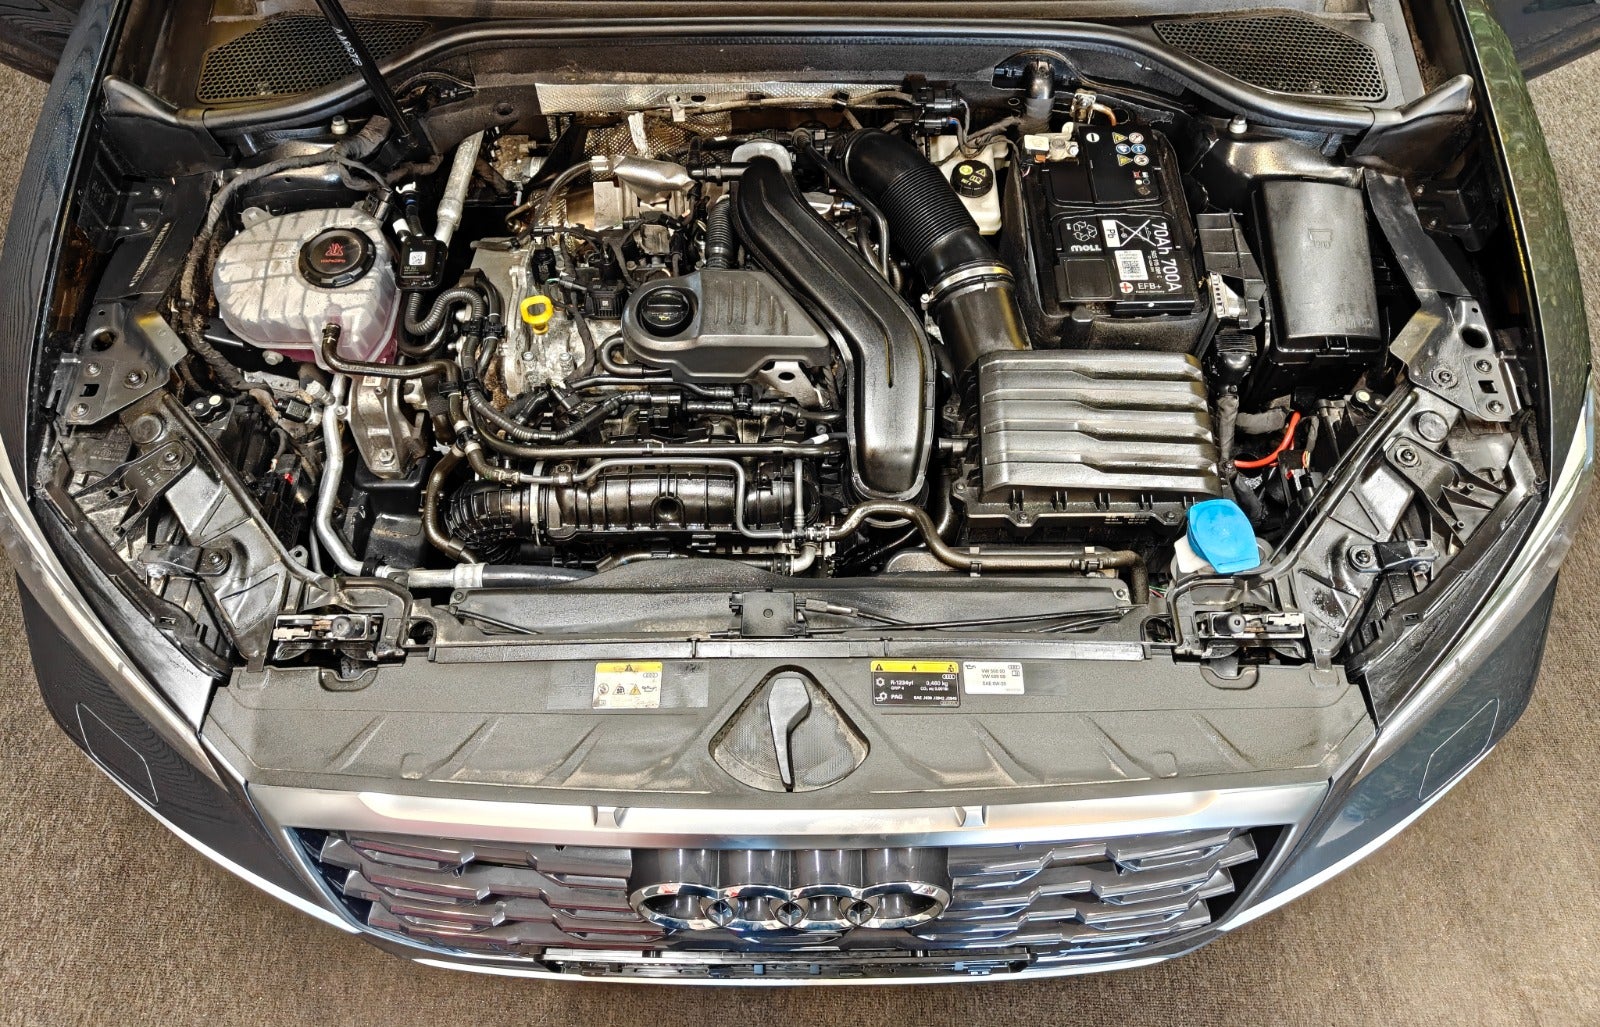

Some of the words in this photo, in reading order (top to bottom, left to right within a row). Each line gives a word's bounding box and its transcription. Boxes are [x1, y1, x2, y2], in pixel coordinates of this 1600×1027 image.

[1106, 229, 1116, 239] Pb
[1152, 222, 1173, 255] 70Ah
[1161, 258, 1182, 292] 700A
[1138, 282, 1162, 290] EFB+
